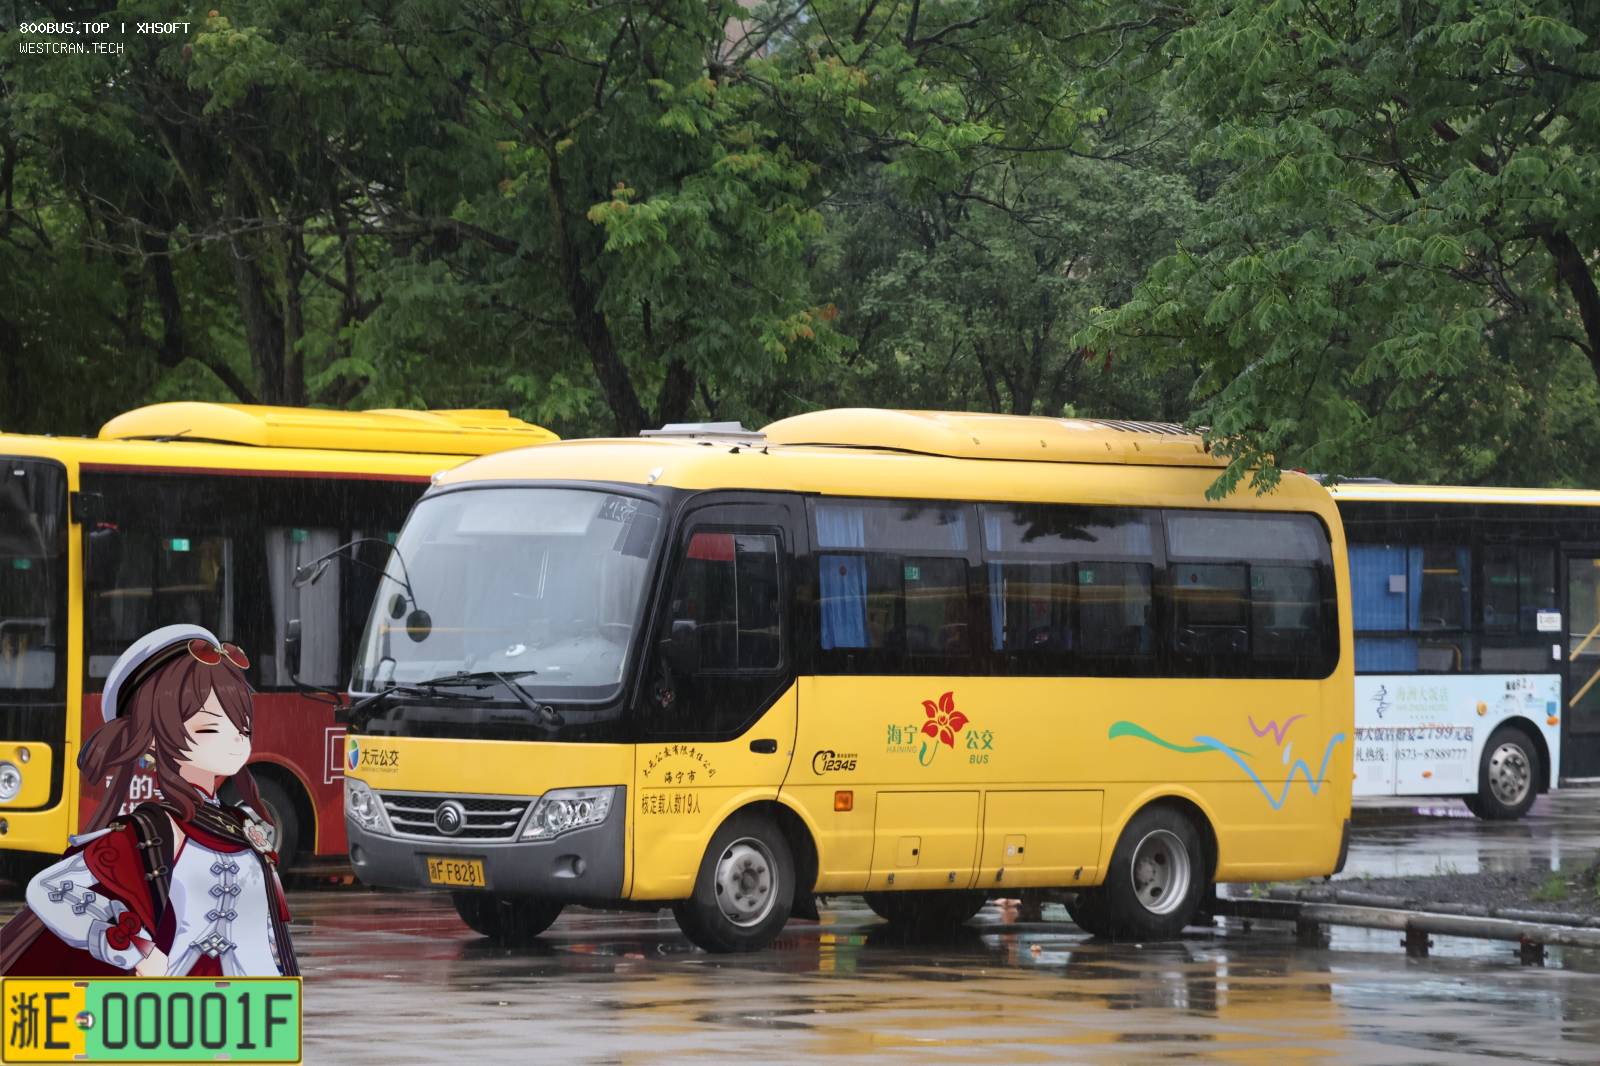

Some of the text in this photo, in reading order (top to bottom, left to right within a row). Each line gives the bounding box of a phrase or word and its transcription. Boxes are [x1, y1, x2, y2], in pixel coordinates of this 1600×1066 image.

[887, 724, 995, 750] 海宁 公交
[361, 748, 400, 767] 大元公交
[886, 745, 989, 765] HAINING BUS
[823, 759, 857, 771] 12345
[664, 770, 697, 784] 海宁市
[641, 793, 701, 815] 核定载人数19人
